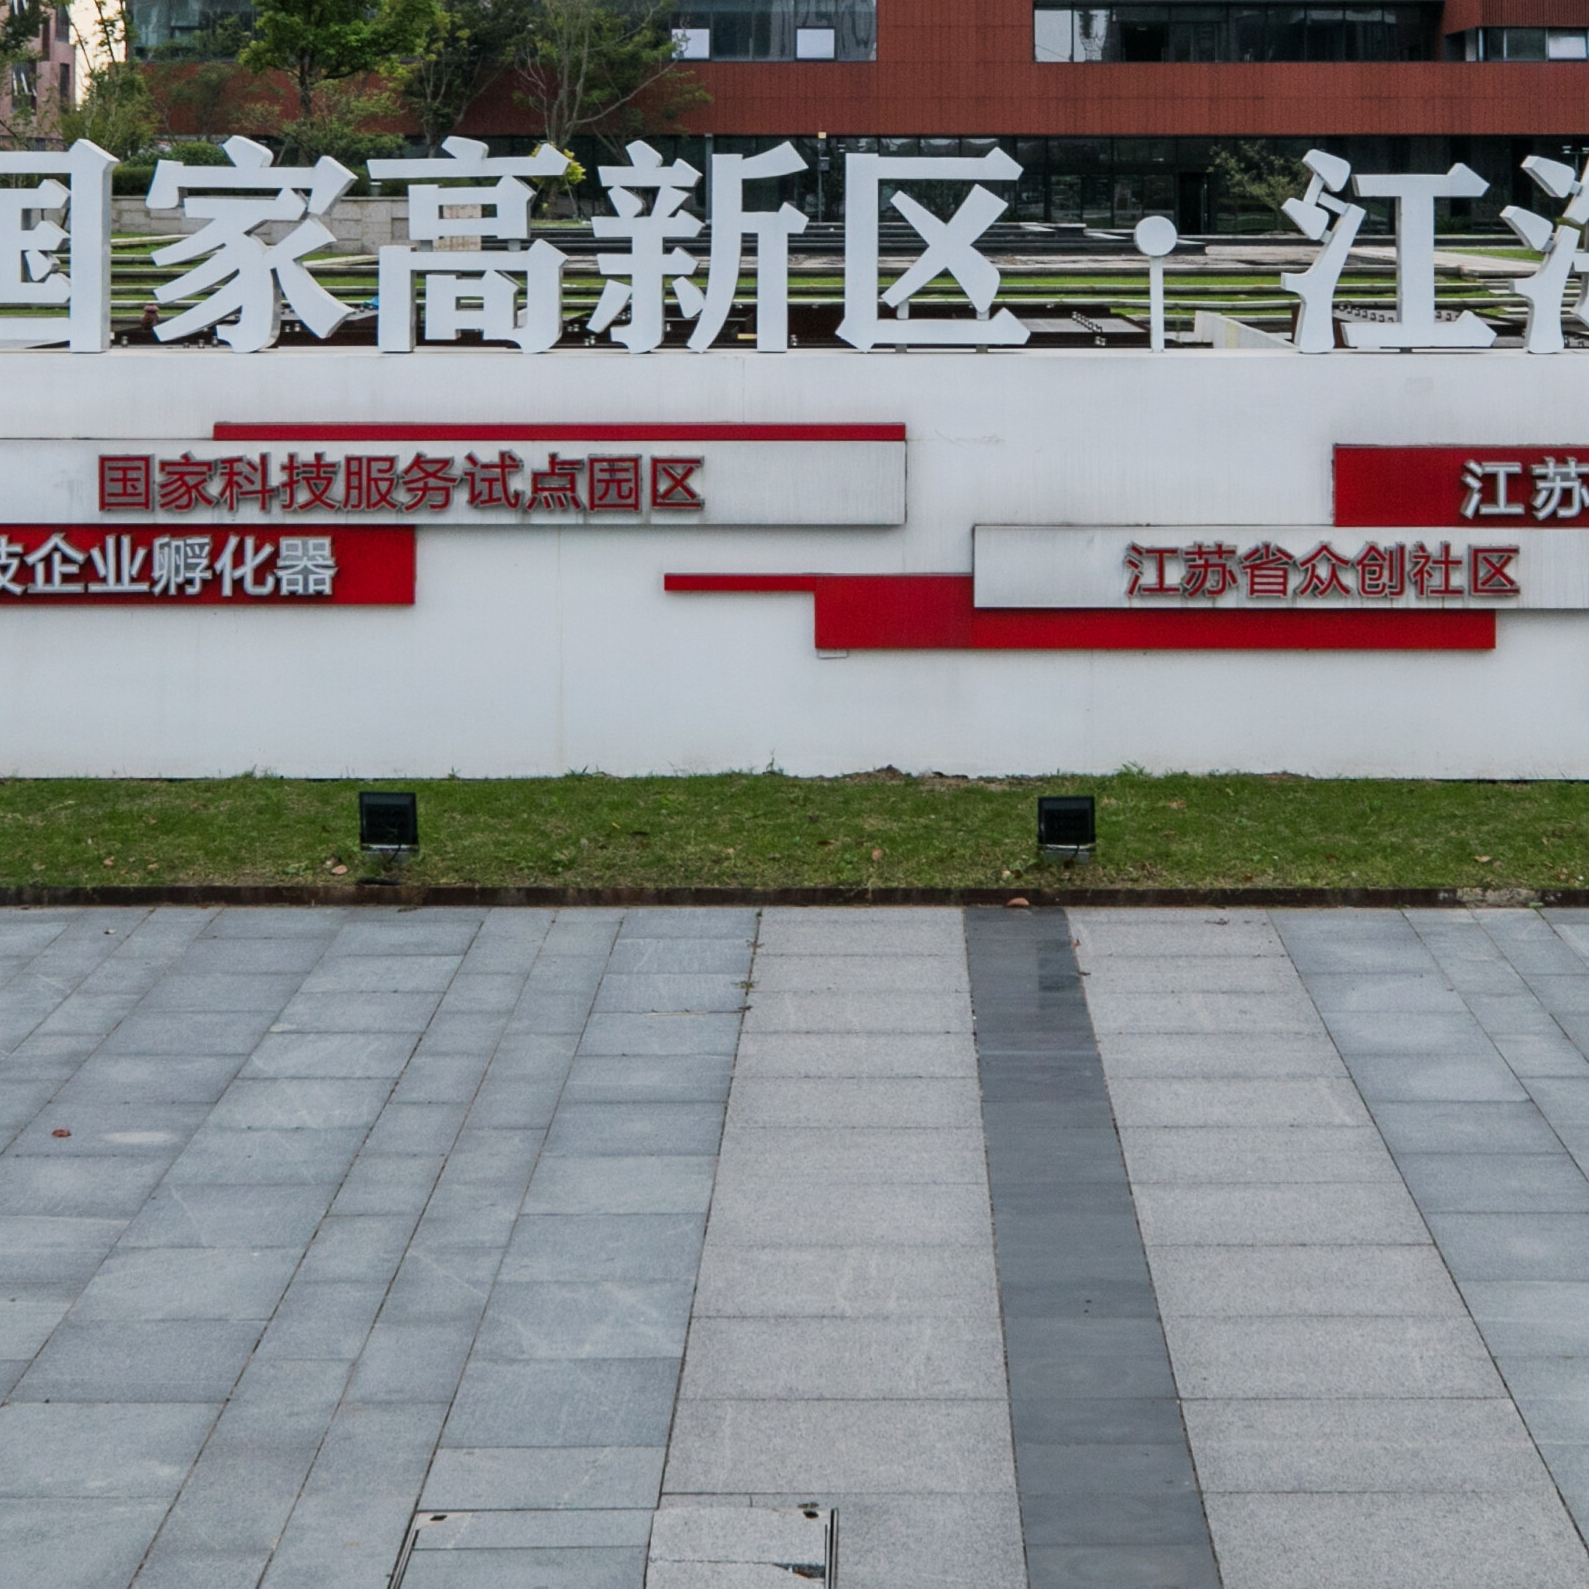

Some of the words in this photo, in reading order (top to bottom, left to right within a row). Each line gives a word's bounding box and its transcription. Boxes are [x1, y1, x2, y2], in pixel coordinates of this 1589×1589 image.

[97, 451, 705, 513] 国家科技服务试点园区
[1124, 541, 1521, 599] 江苏省众创社区
